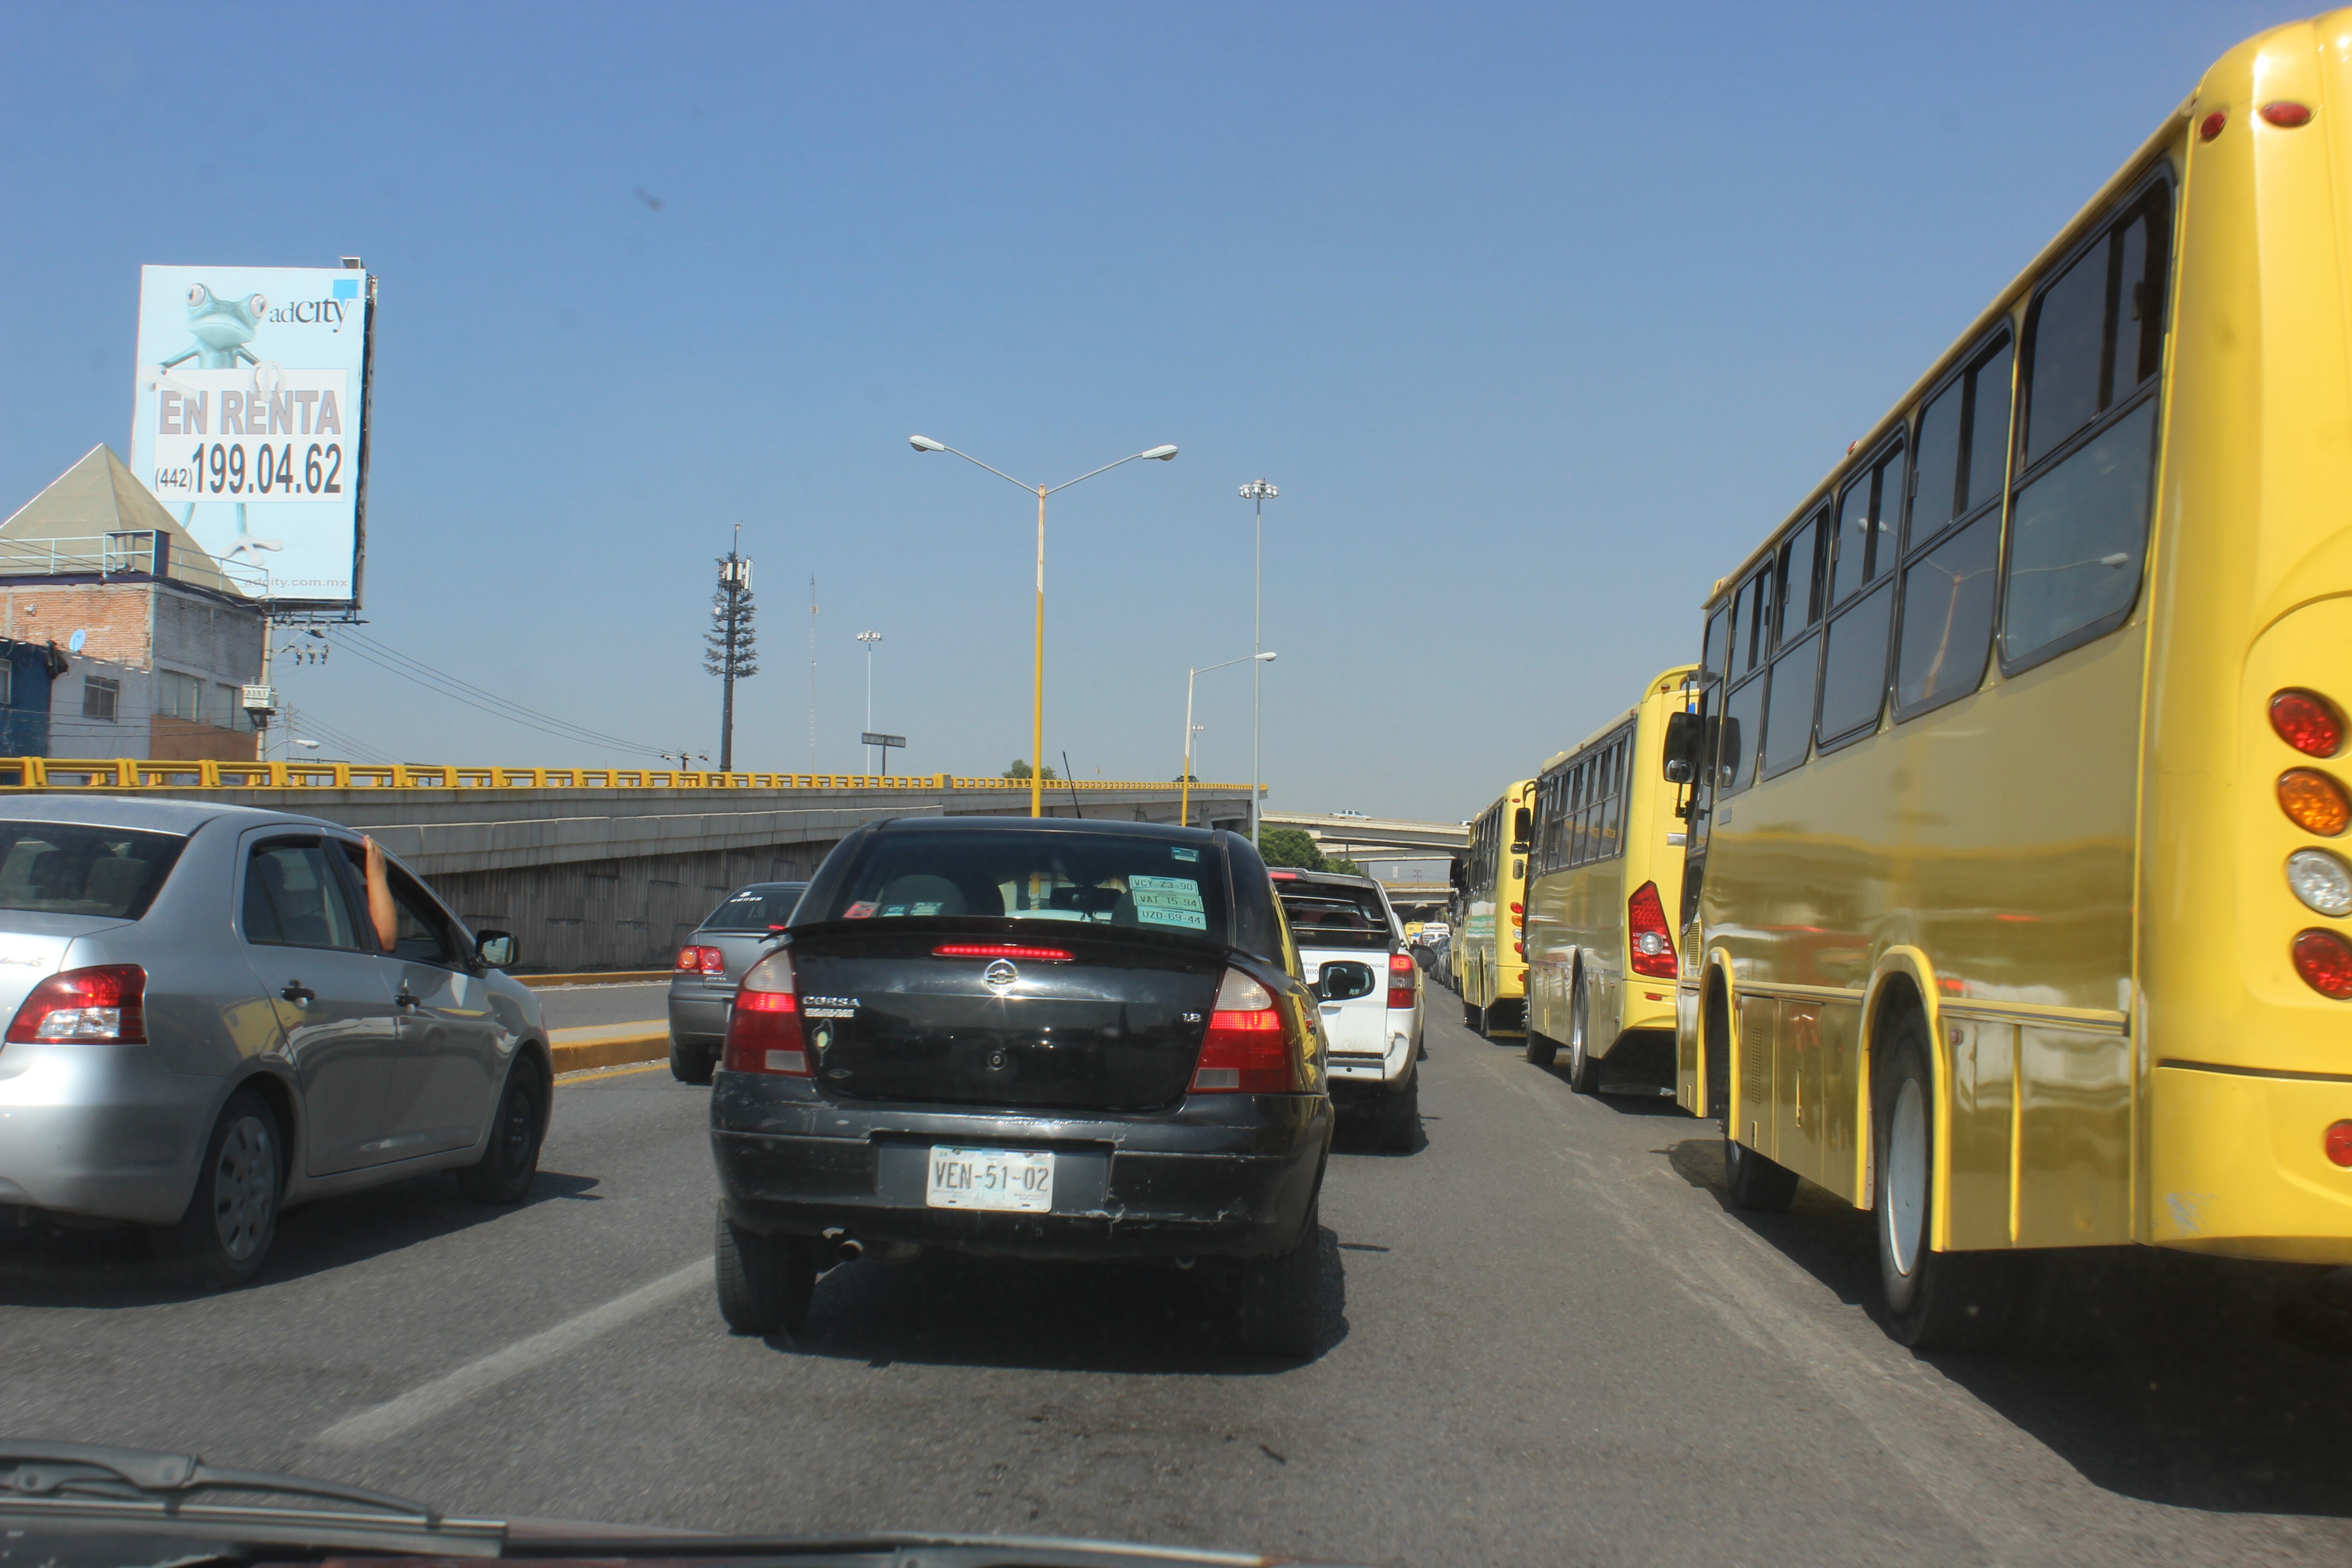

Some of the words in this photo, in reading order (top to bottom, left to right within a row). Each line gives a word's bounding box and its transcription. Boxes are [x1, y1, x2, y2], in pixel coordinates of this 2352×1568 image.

[160, 390, 208, 435] EN
[221, 390, 342, 435] RENTA
[803, 996, 861, 1007] CORSA
[936, 1161, 1049, 1192] VEN-51-02
